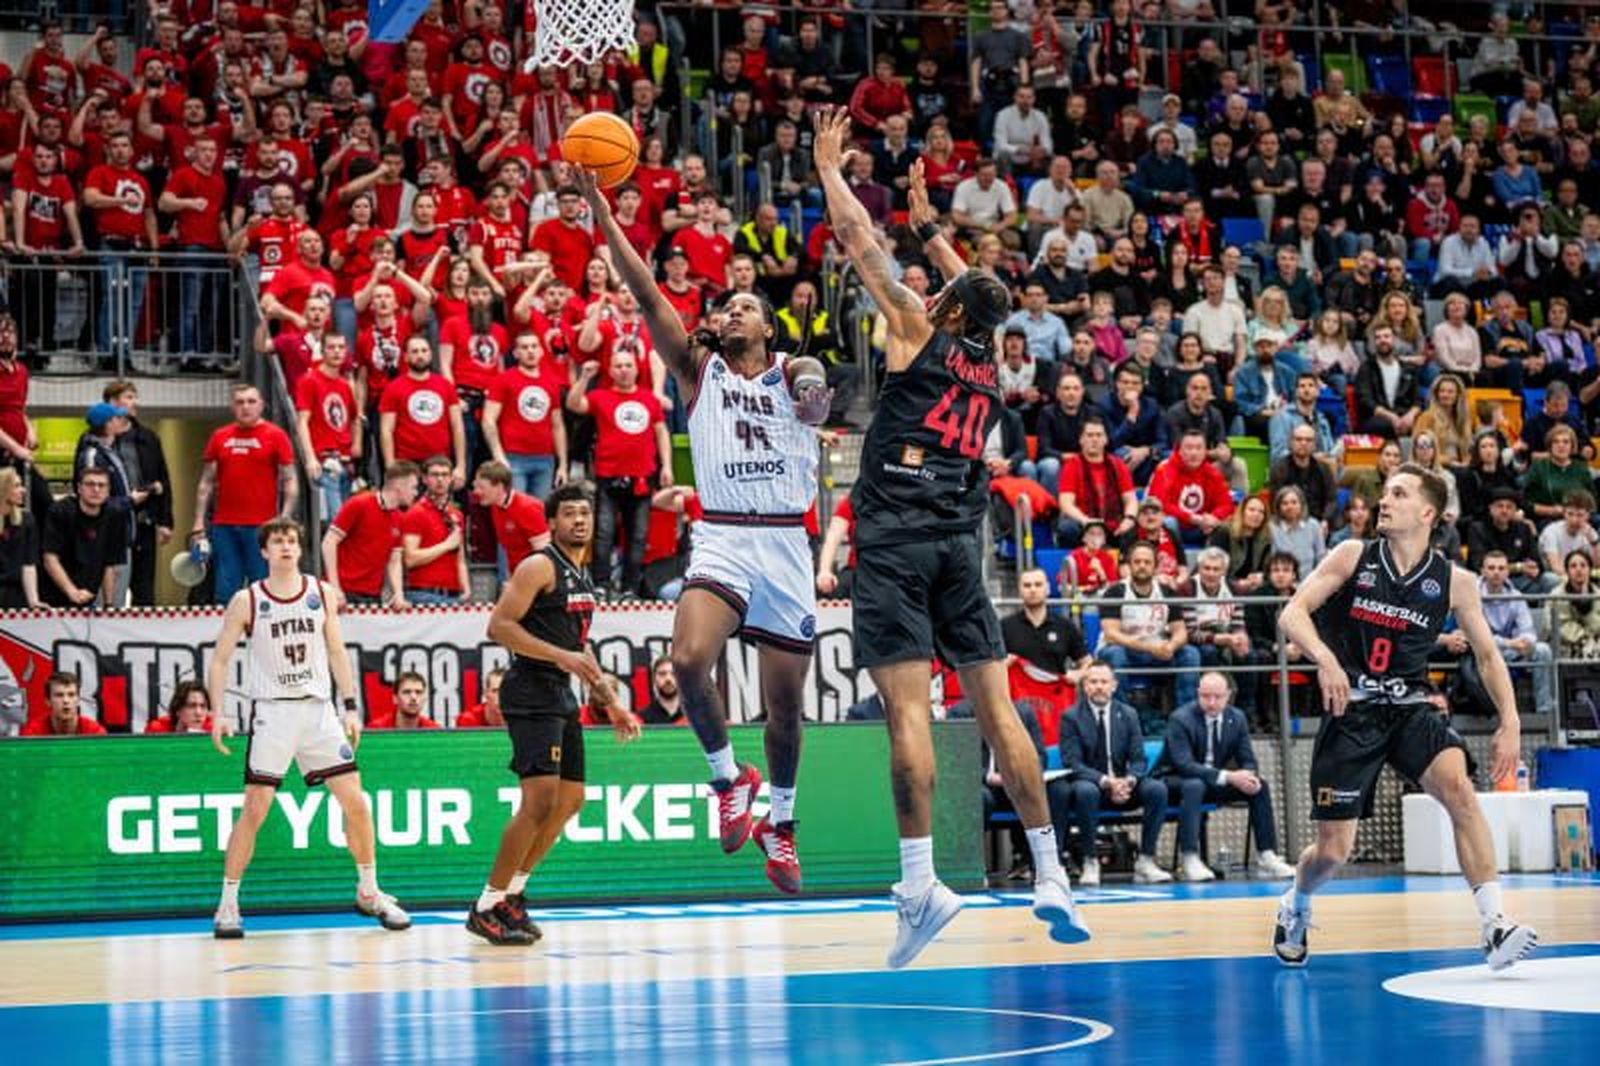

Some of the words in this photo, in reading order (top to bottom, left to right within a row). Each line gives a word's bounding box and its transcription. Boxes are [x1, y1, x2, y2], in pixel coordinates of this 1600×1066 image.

[924, 384, 990, 460] 40
[723, 459, 785, 479] UTENOS
[271, 617, 315, 639] RYTAS
[1352, 597, 1430, 628] BASKETBALL
[1369, 637, 1392, 673] 8
[107, 793, 246, 854] GET
[275, 788, 472, 849] YOUR
